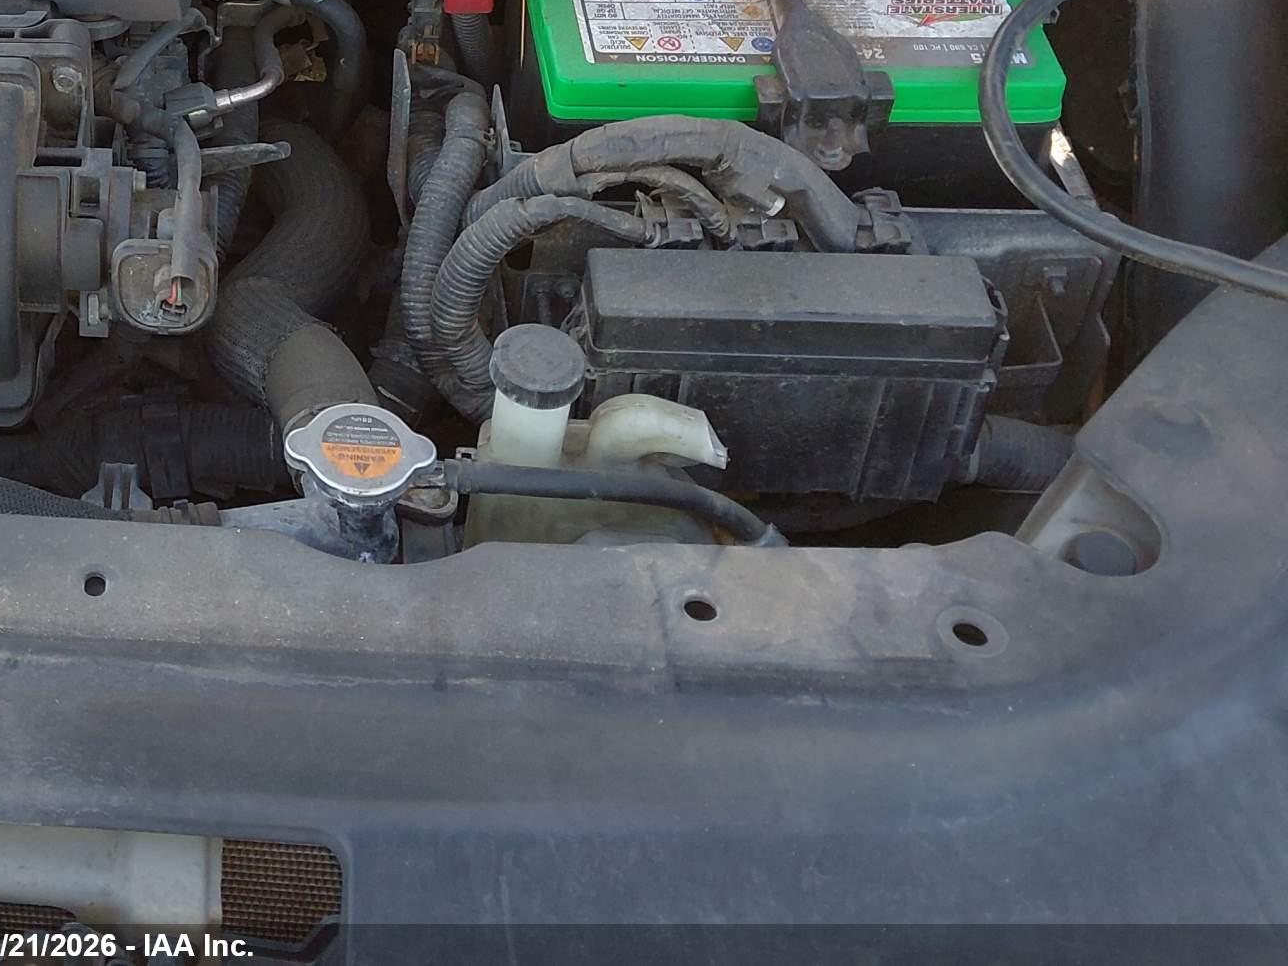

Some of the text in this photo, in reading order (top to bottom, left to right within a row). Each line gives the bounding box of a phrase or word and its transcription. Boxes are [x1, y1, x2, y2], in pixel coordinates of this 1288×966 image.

[888, 5, 1001, 15] INTERSTATE
[635, 53, 746, 63] DANGER/POISON
[856, 48, 885, 59] 24-
[337, 453, 385, 463] WARNING
